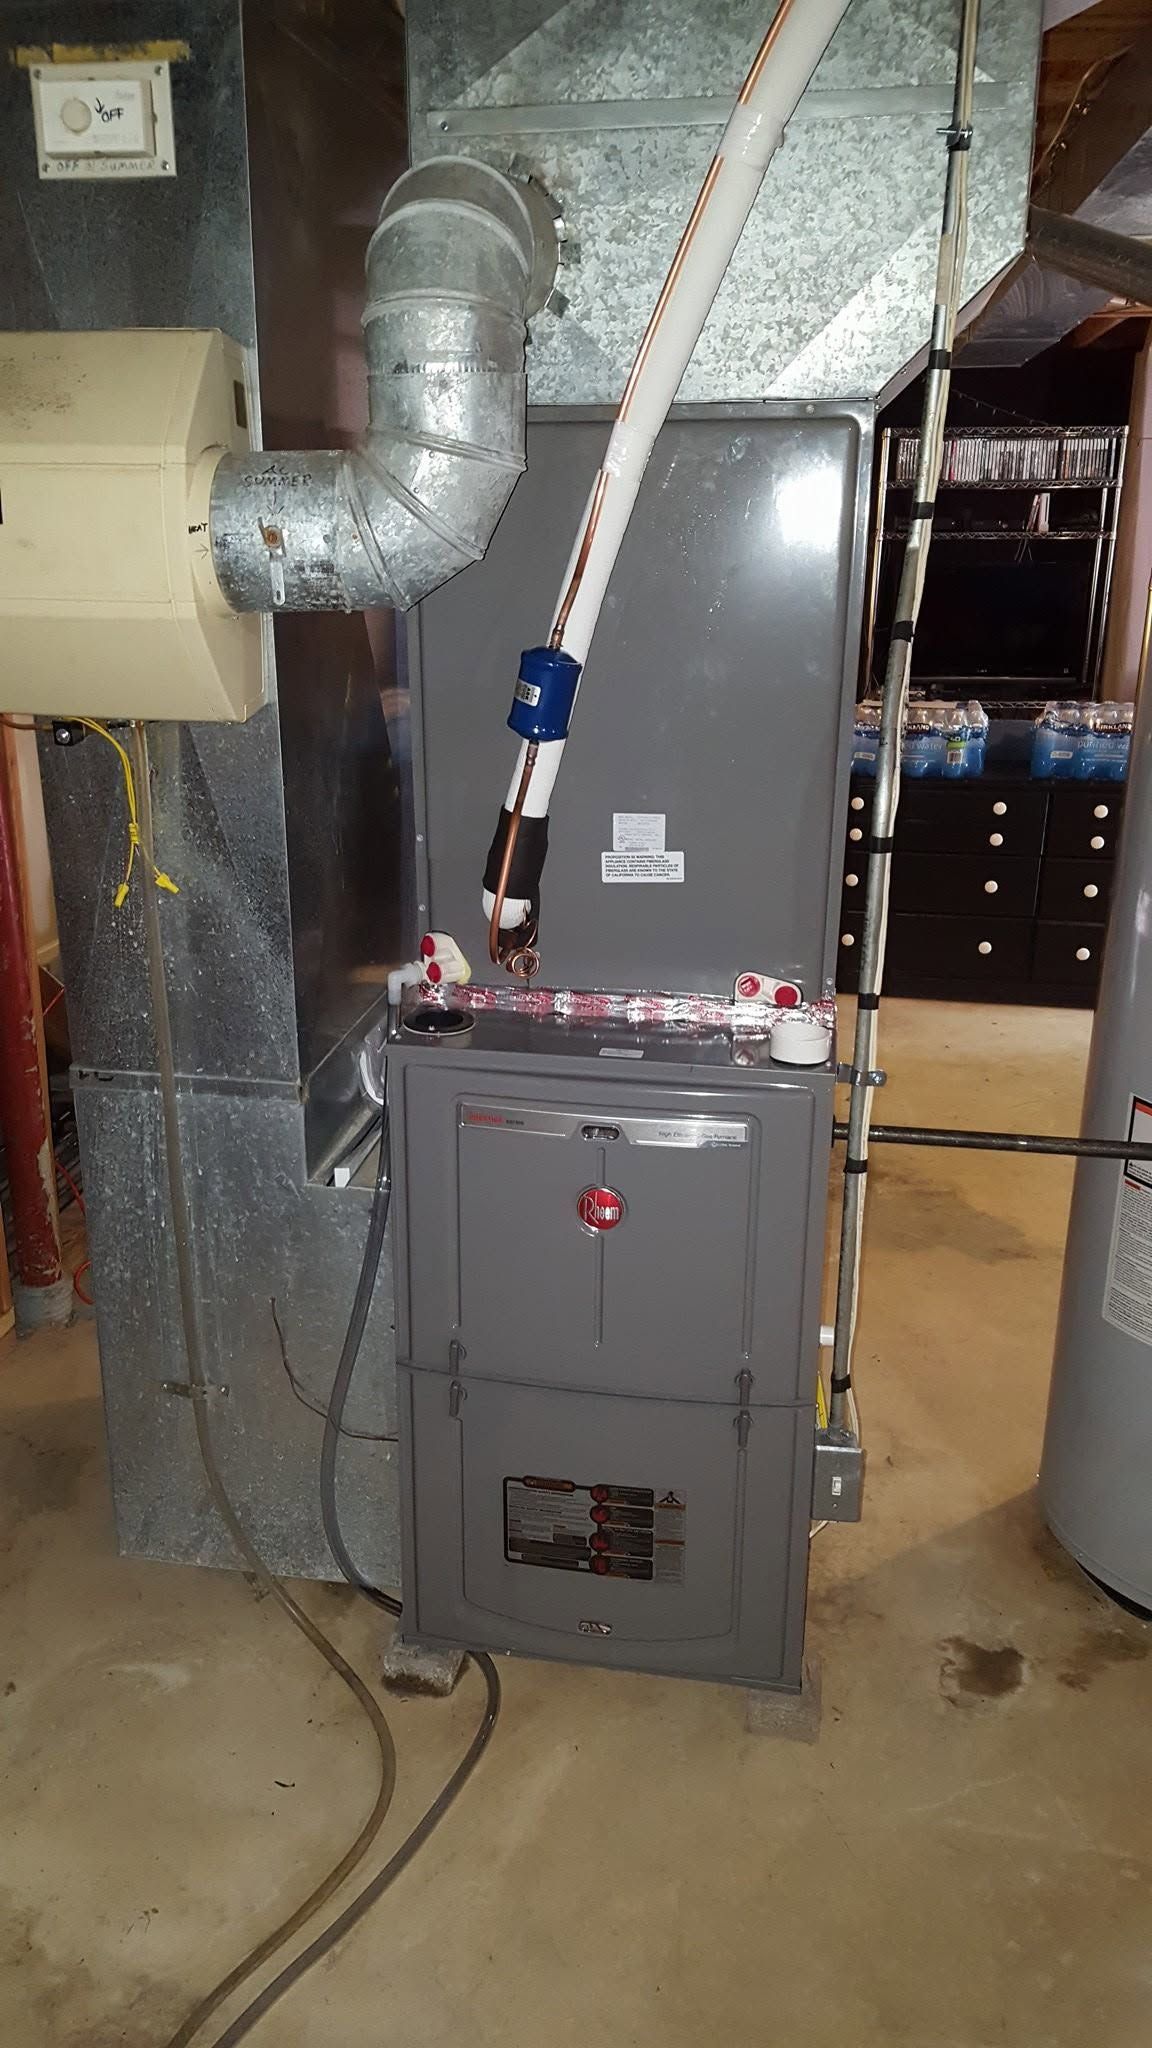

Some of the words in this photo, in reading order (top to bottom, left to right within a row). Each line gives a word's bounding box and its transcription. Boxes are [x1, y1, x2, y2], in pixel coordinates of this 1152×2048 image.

[101, 108, 124, 123] OFF
[57, 161, 79, 172] OFF
[100, 160, 155, 171] SUMMER
[262, 465, 288, 475] AC
[243, 473, 312, 487] SUMMER
[188, 522, 208, 534] HEAT
[582, 1191, 619, 1224] Rheem
